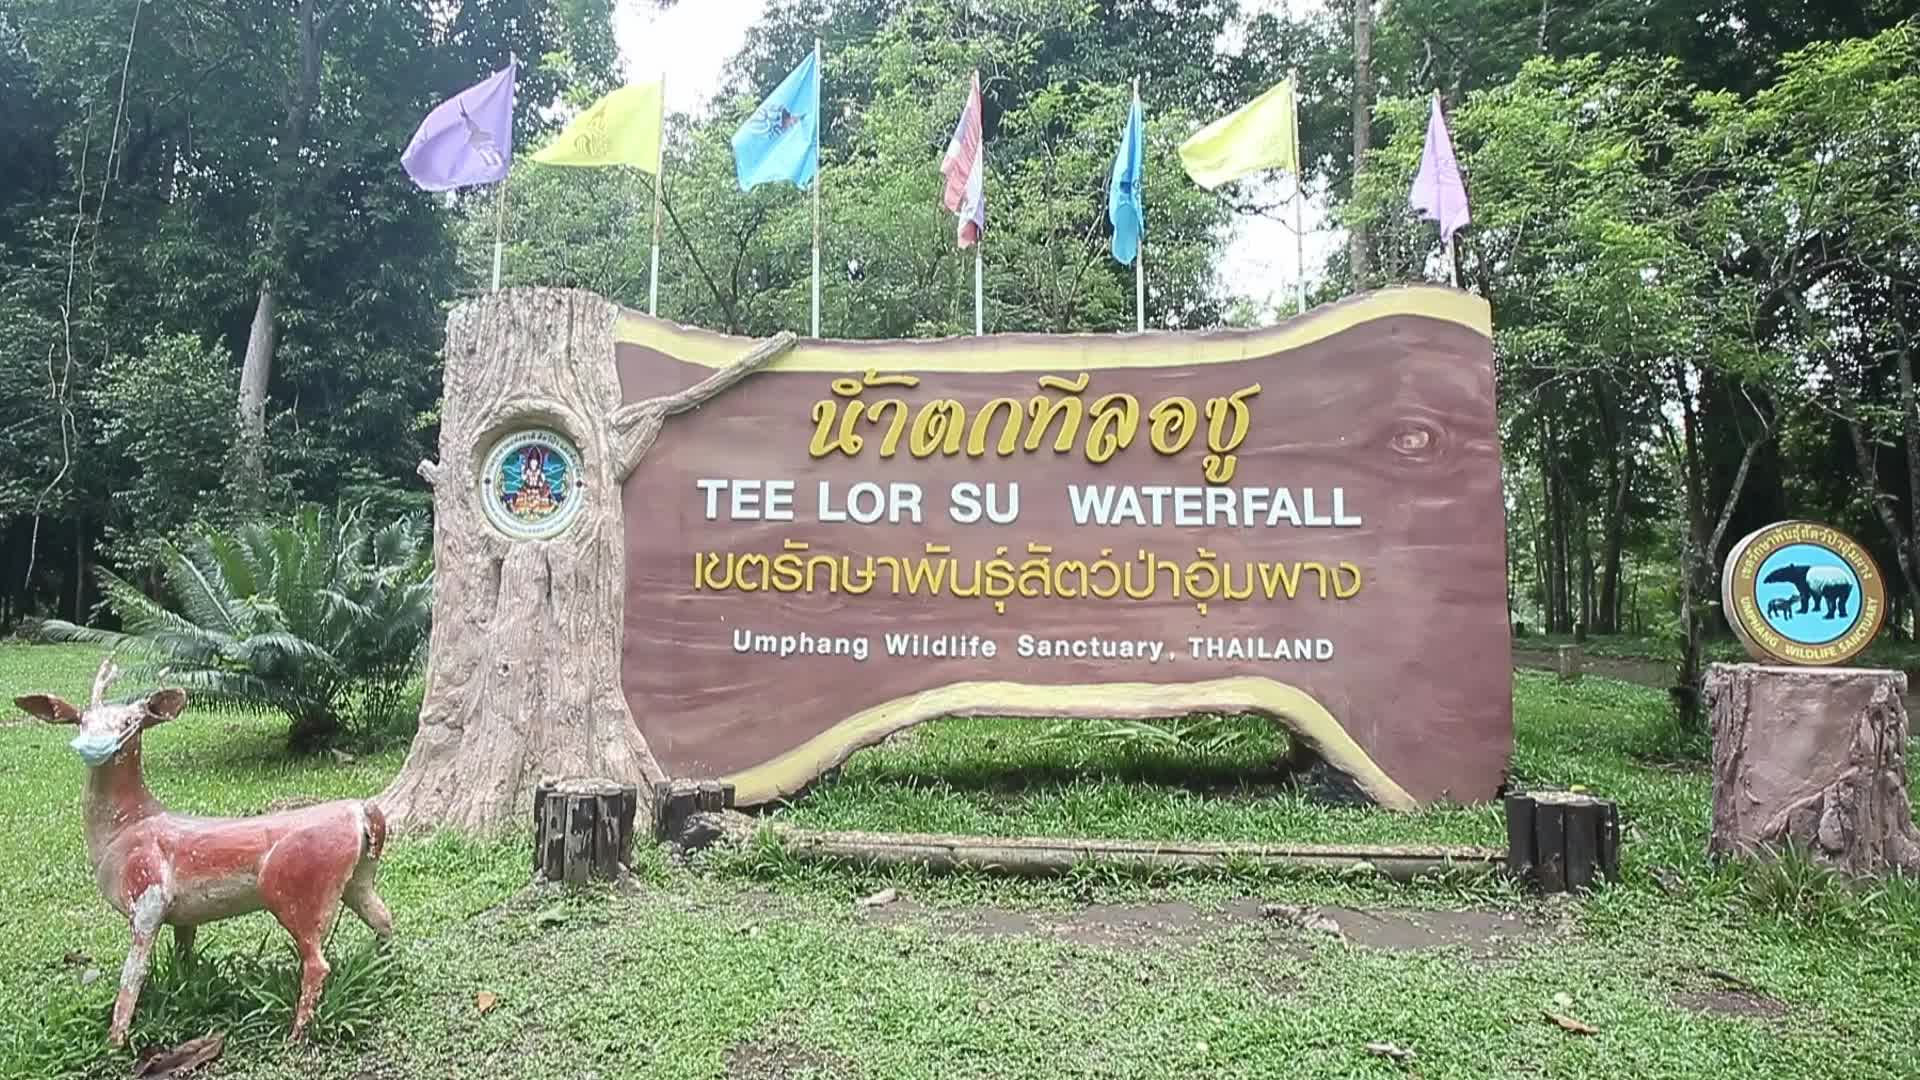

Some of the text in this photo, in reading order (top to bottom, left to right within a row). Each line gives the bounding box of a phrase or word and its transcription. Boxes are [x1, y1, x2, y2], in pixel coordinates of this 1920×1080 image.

[809, 368, 1261, 483] น้ำตกทีลอซู
[697, 479, 1362, 527] TEE LOR SU WATERFALL
[695, 538, 1362, 615] เขตรักษาพันธุ์สัตว์ป่าอุ้มผาง
[733, 628, 1335, 662] Umphang Wildlife Sanctuary, THAILAND
[1740, 596, 1879, 660] UMPHANG WILDLIFE SANCTUARY
